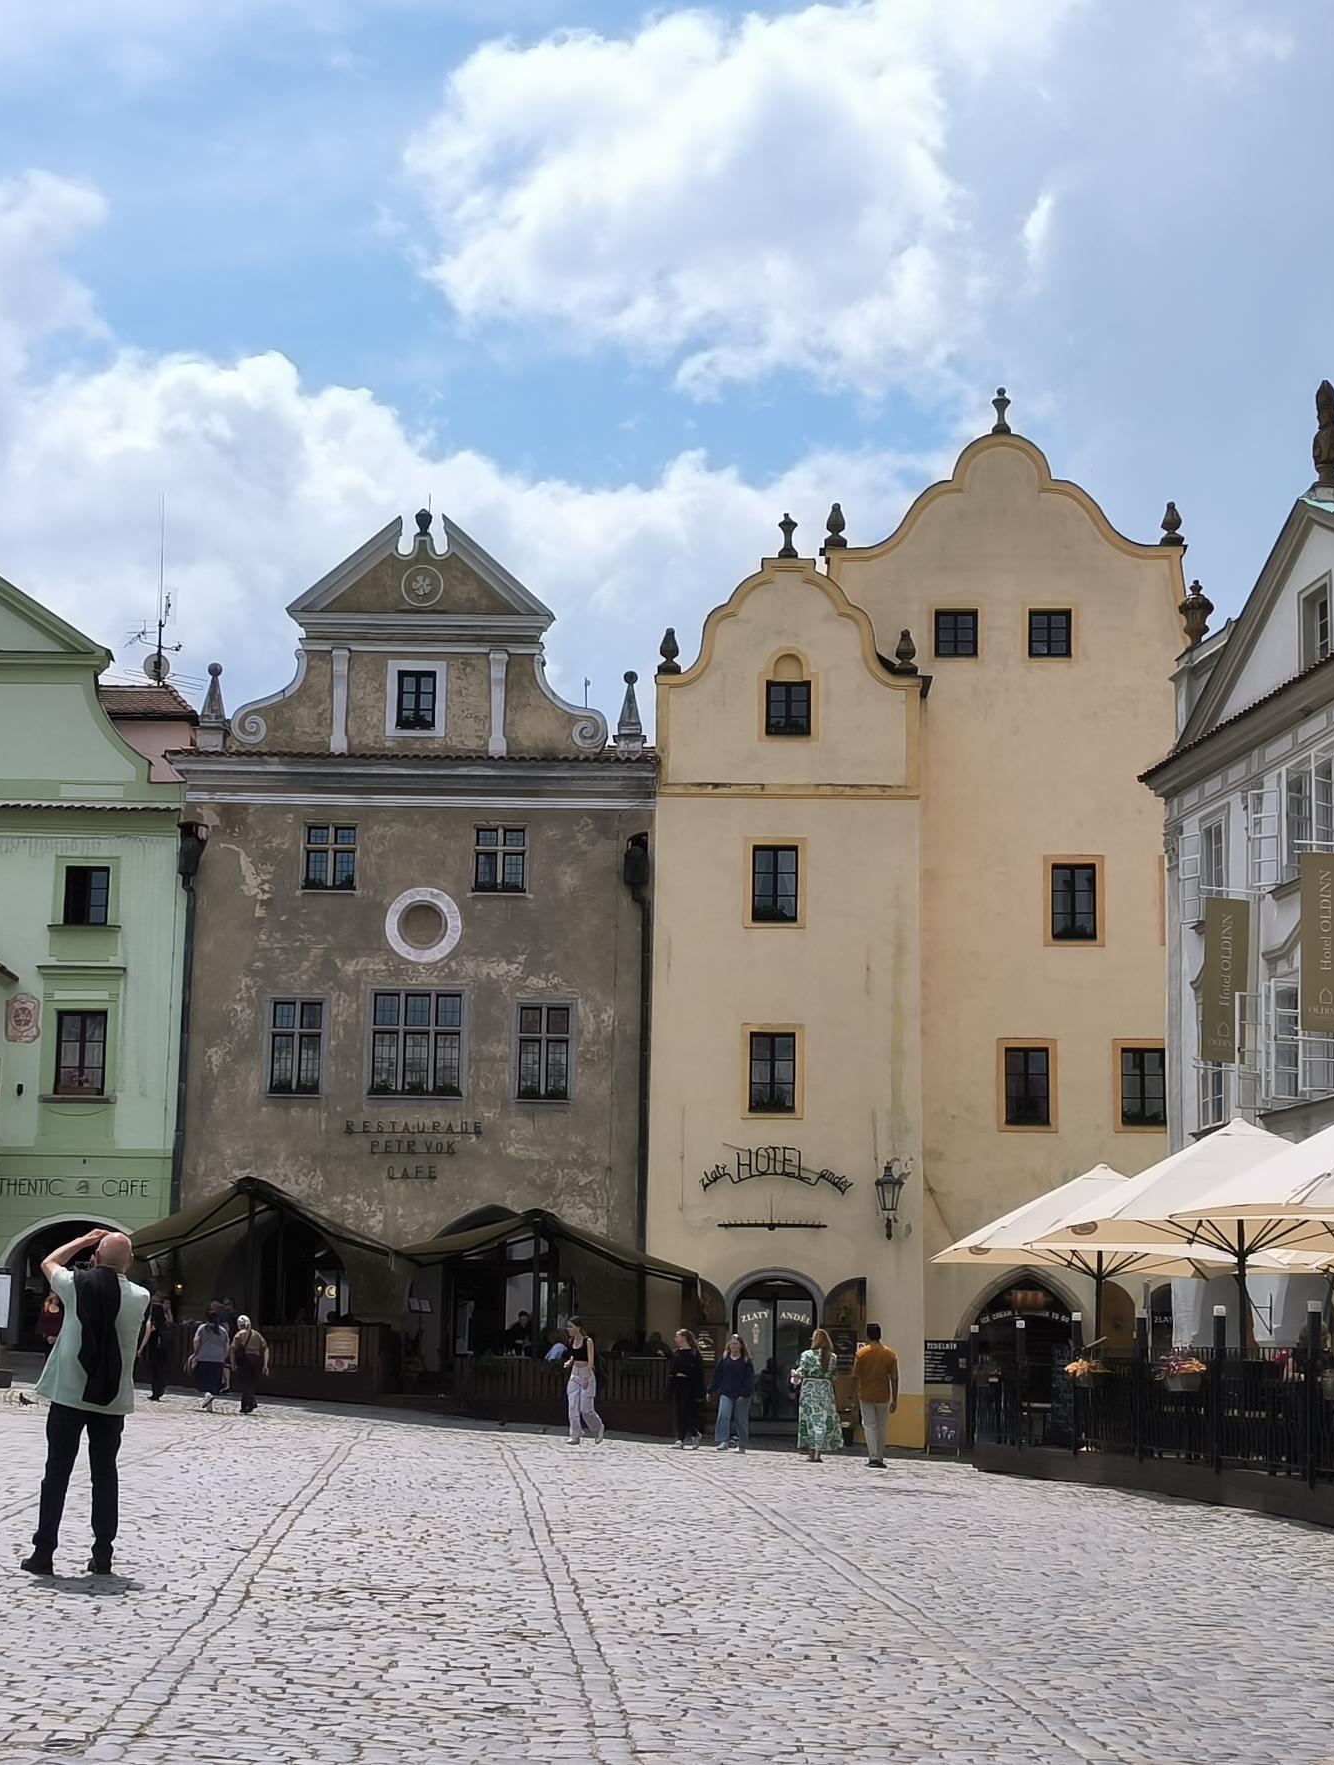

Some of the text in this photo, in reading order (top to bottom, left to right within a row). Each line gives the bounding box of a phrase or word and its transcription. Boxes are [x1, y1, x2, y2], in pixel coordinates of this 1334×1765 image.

[1319, 869, 1332, 971] Hotel OLDINN
[1219, 913, 1233, 1007] Hotel OLDINN
[370, 1139, 457, 1154] PETR VOK
[386, 1164, 438, 1180] CAFE
[736, 1145, 811, 1181] HOTEL
[818, 1168, 854, 1193] anděl
[101, 1179, 151, 1198] CAFE
[740, 1308, 770, 1323] ZLATÝ
